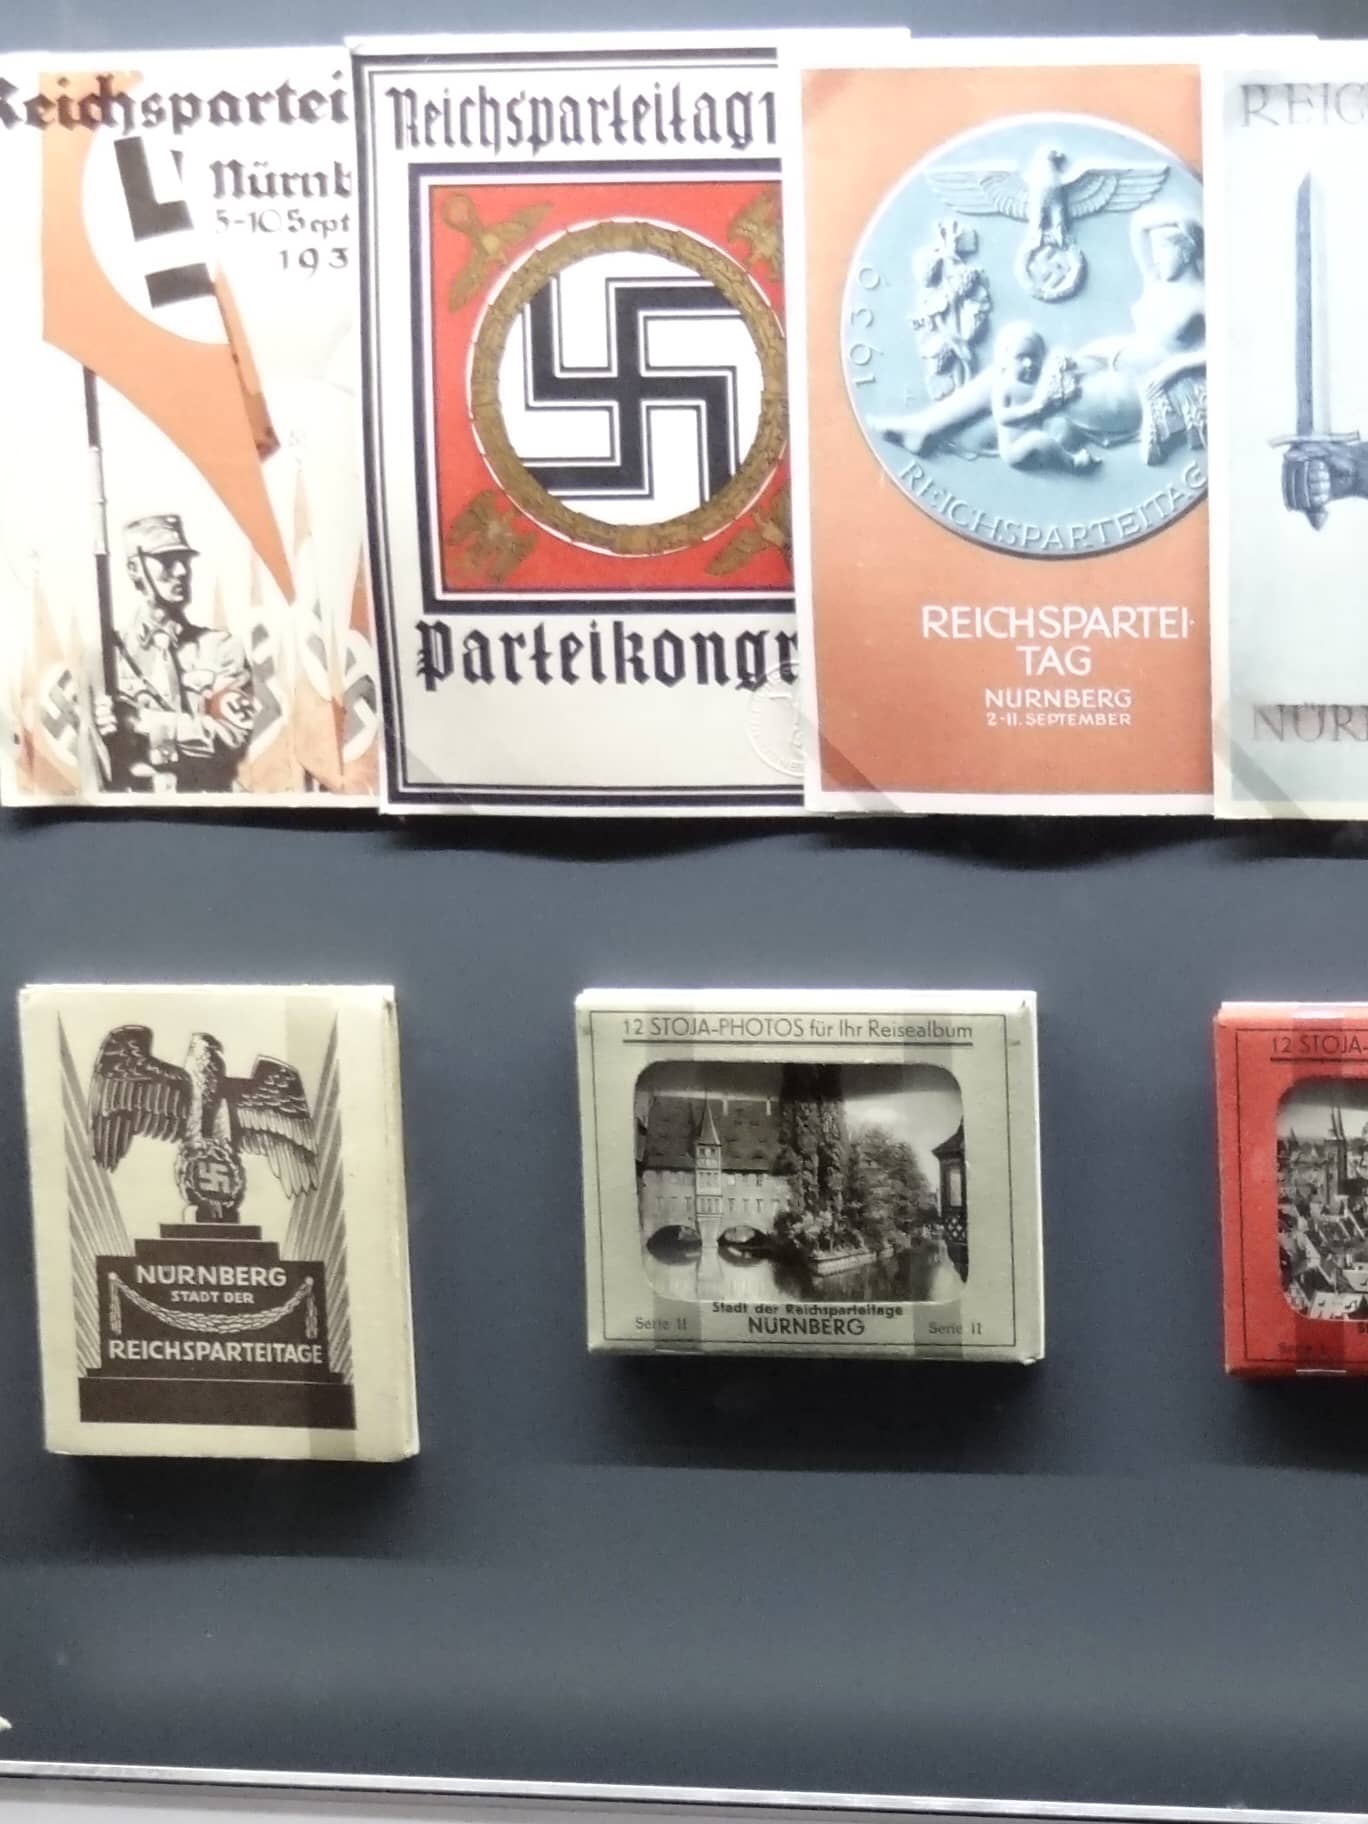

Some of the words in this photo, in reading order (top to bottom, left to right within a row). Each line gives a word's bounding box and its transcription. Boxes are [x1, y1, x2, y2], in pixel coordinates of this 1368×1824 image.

[279, 247, 349, 279] 193
[899, 459, 1207, 552] REICHSPARTEITAG
[1016, 644, 1092, 676] TAG
[1026, 712, 1131, 727] SEPTEMBER
[623, 1018, 644, 1036] 12
[650, 1017, 805, 1038] STOJA-PHOTOS
[809, 1019, 834, 1038] für
[839, 1019, 863, 1038] Ihr
[868, 1019, 974, 1040] Reisealbum
[1270, 1035, 1292, 1054] 12
[170, 1289, 220, 1303] STADT
[222, 1291, 256, 1304] DER
[711, 1301, 749, 1315] Stadt
[754, 1303, 779, 1316] der
[108, 1340, 324, 1365] REICHSPARTEITAGE
